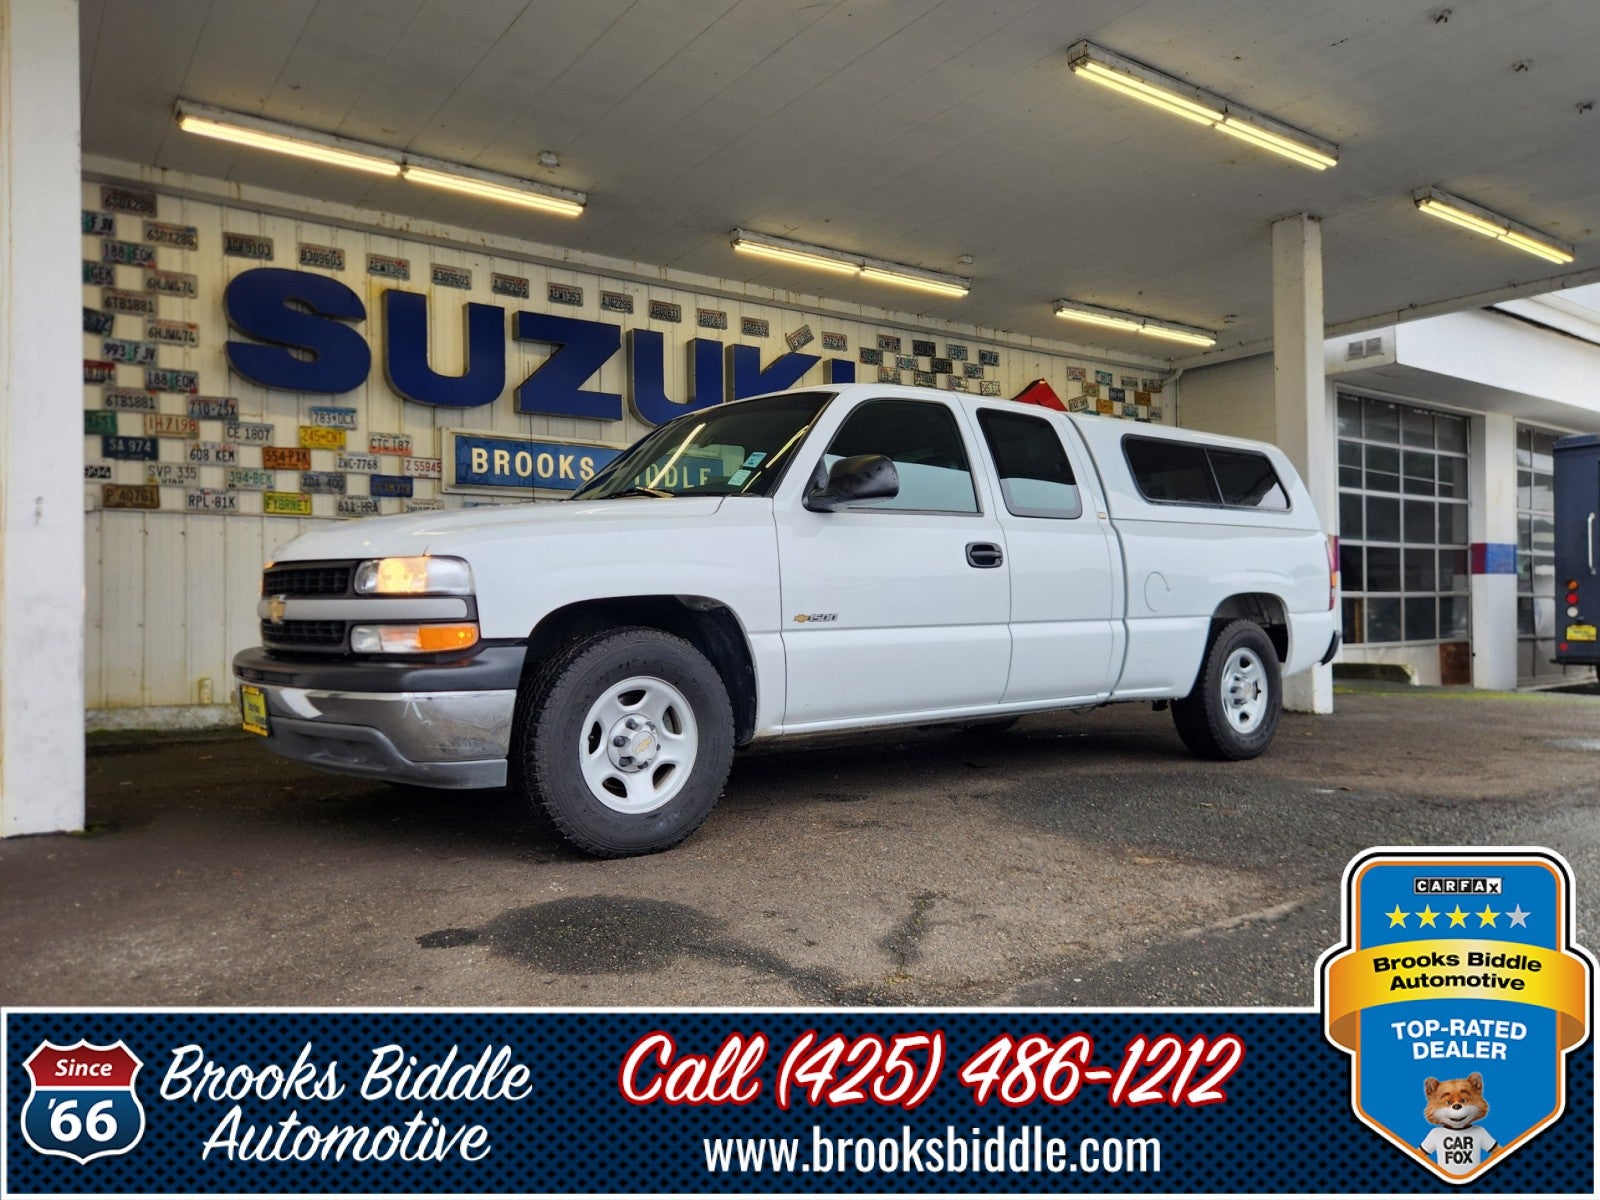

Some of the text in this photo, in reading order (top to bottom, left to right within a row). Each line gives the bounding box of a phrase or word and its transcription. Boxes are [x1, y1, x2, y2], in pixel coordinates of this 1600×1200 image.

[224, 267, 857, 428] SUZUK
[226, 426, 271, 441] CE 1807
[108, 437, 152, 452] SA 974
[370, 438, 410, 452] CTC 187
[189, 448, 235, 462] 608 KEM
[405, 460, 442, 474] Z 55945
[471, 447, 596, 481] BROOKS
[147, 464, 198, 480] SVP 335
[809, 612, 839, 623] 1500
